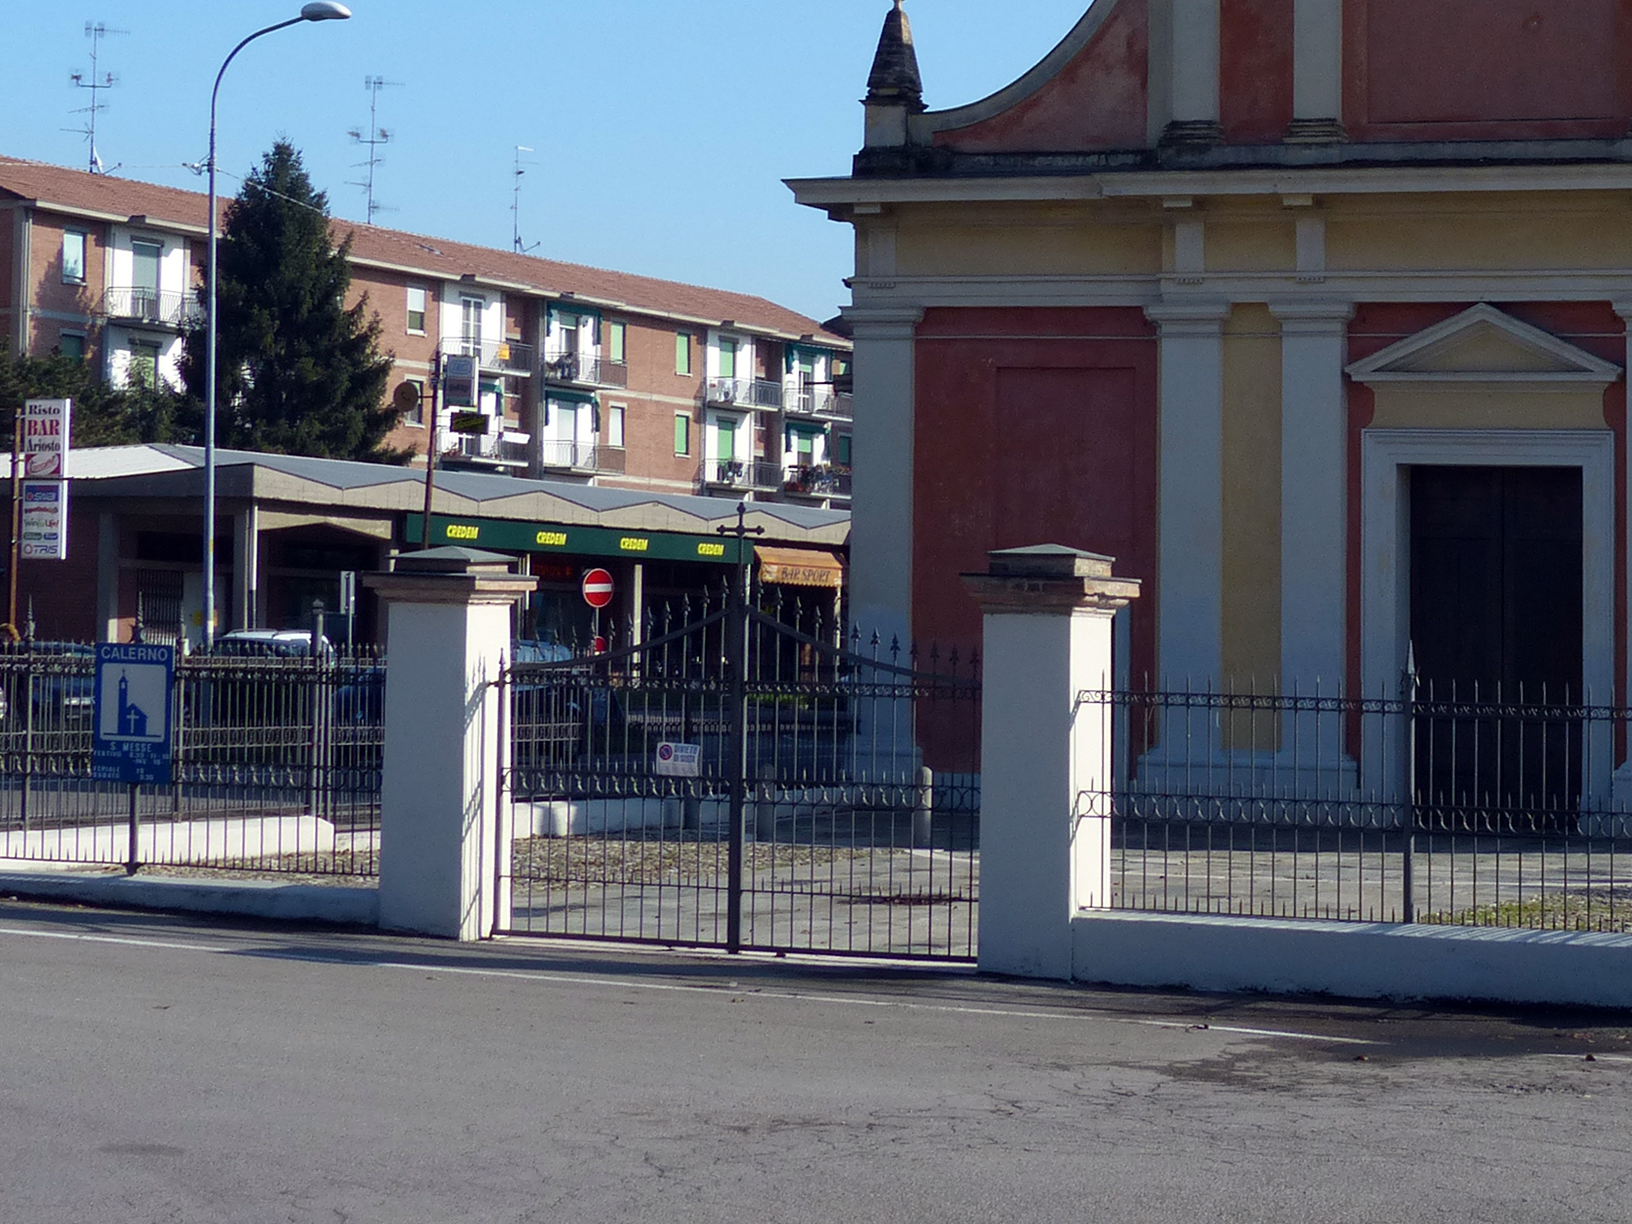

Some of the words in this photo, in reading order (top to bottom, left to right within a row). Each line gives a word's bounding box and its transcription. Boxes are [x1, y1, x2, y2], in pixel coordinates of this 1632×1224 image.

[29, 404, 60, 415] Risto
[27, 419, 60, 436] BAR
[27, 438, 61, 452] Ariosto
[446, 524, 479, 539] CREDEM
[536, 532, 567, 546] CREDEM
[620, 537, 648, 551] CREDEM
[34, 545, 58, 554] TRIS
[697, 543, 724, 556] CREDEM
[781, 567, 800, 580] BAR
[802, 568, 831, 583] SPORT
[101, 646, 168, 661] CALERNO
[122, 742, 153, 753] MESSE
